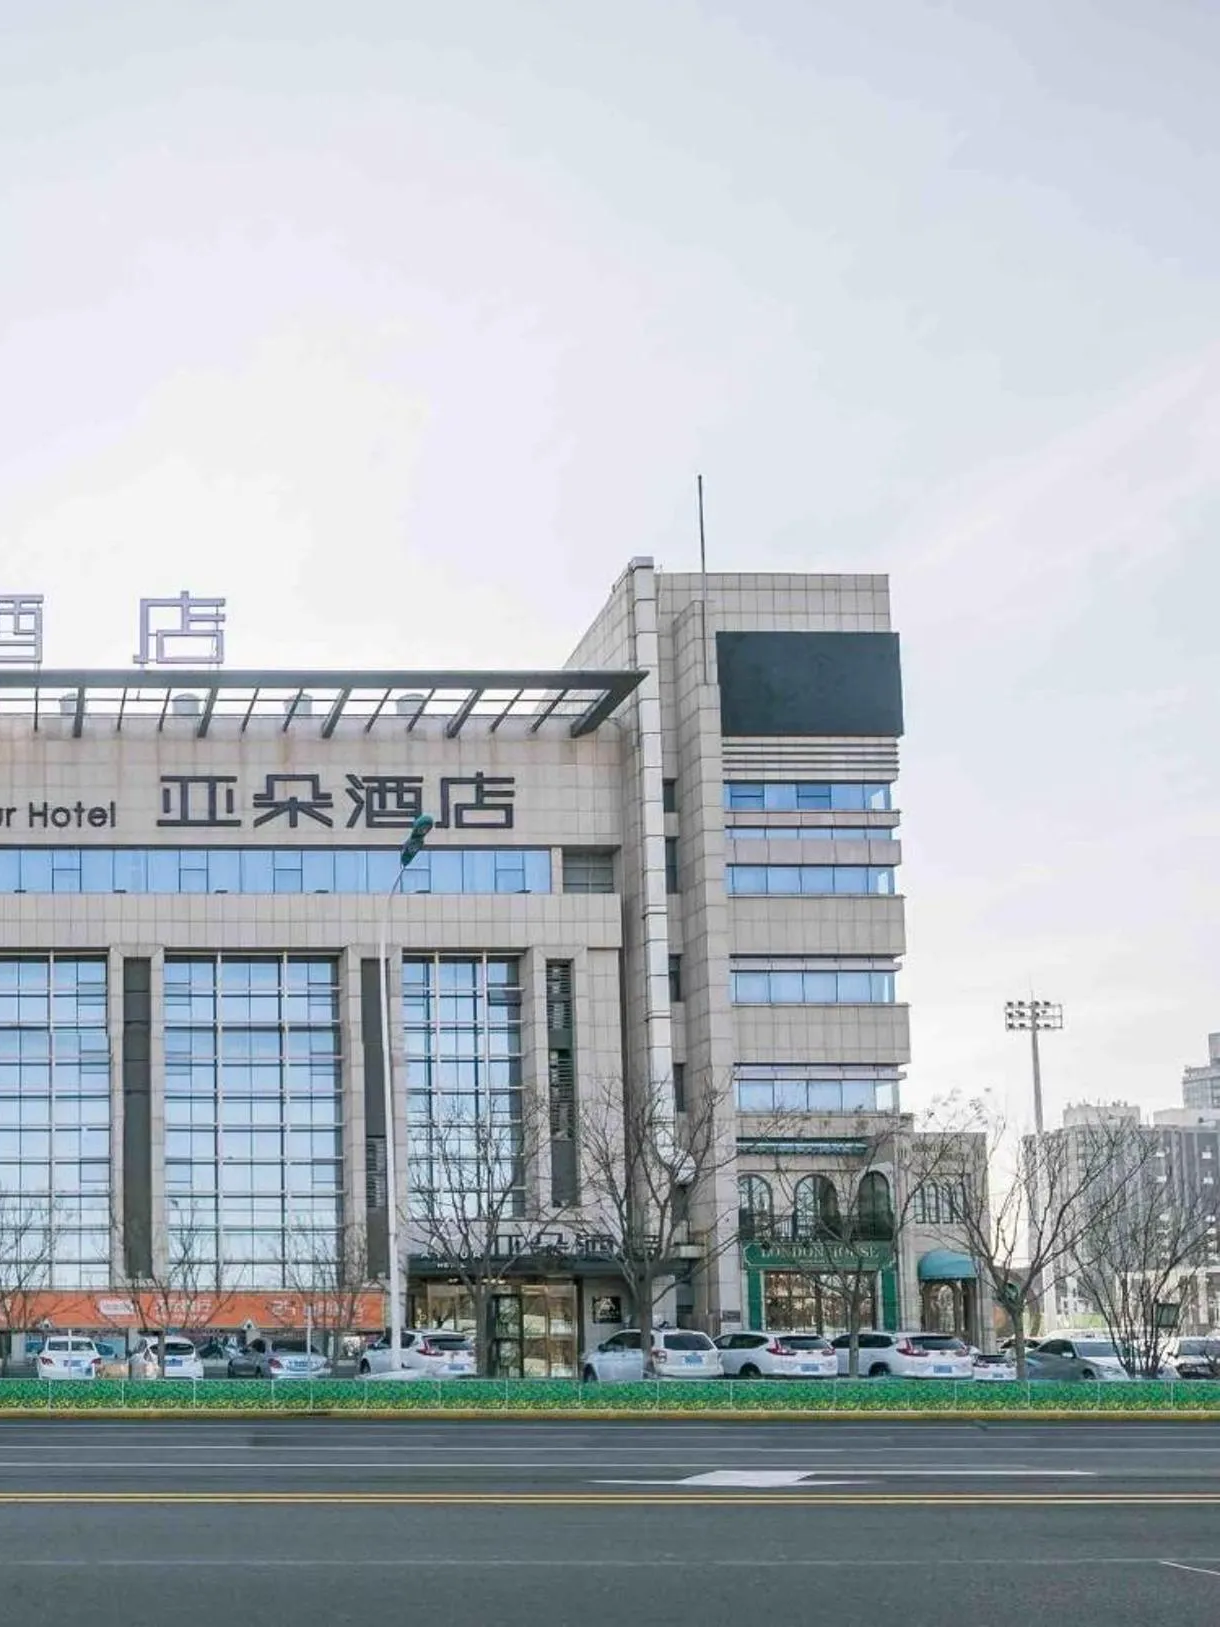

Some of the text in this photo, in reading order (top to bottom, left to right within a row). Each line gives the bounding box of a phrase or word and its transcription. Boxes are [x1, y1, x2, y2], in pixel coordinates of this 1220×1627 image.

[29, 800, 116, 828] Hotel
[156, 771, 516, 828] 亚朵酒店
